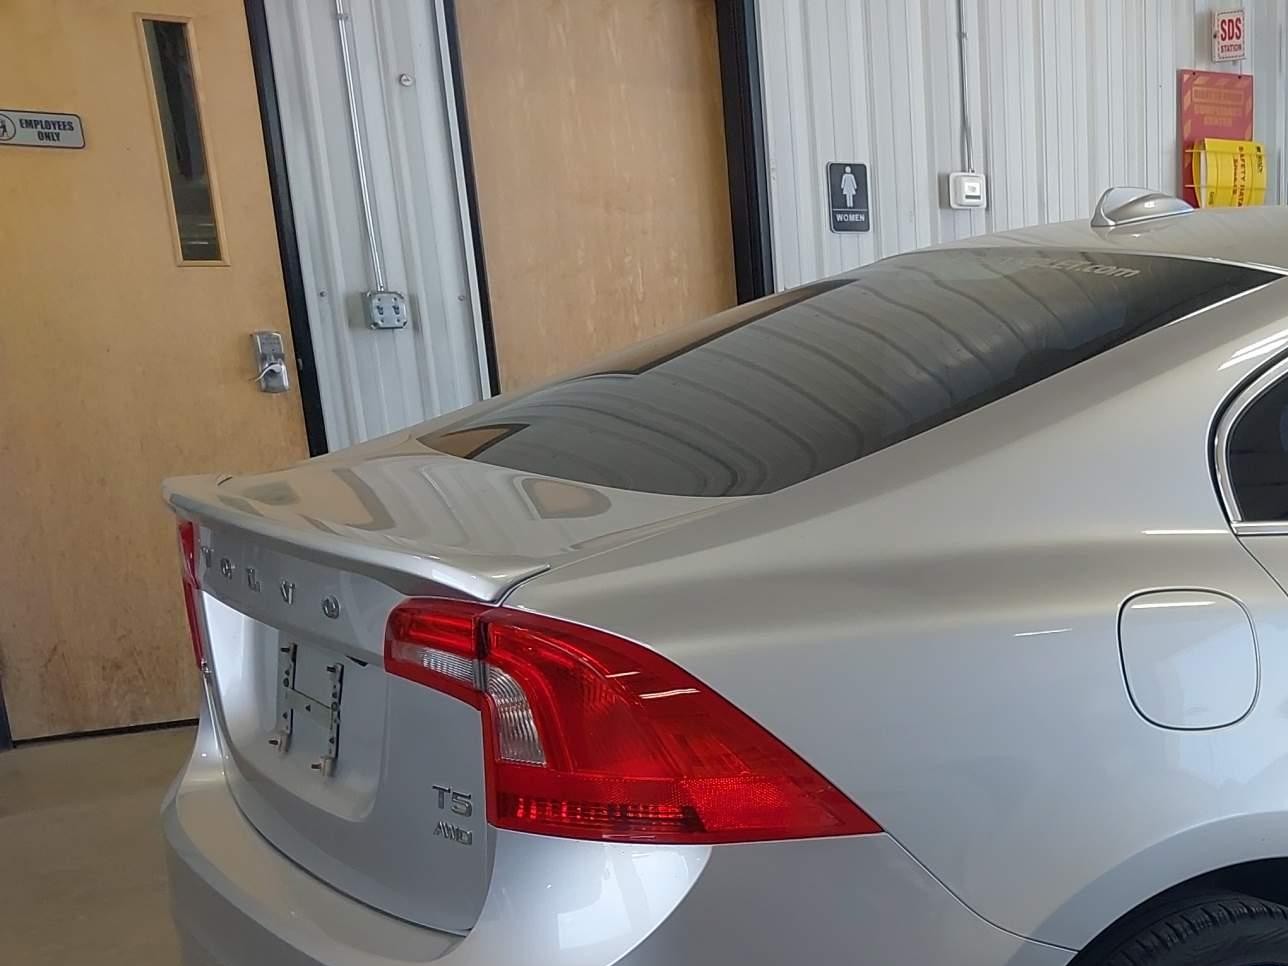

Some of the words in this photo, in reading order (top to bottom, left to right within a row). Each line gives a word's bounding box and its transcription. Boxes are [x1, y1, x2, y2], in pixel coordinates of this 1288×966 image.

[1220, 17, 1242, 41] SDS
[19, 118, 75, 131] EMPLOYEES
[37, 130, 61, 142] ONLY
[836, 213, 865, 222] WOMEN
[202, 545, 341, 619] VOLVO
[432, 784, 472, 817] T5
[432, 821, 472, 845] AWD
